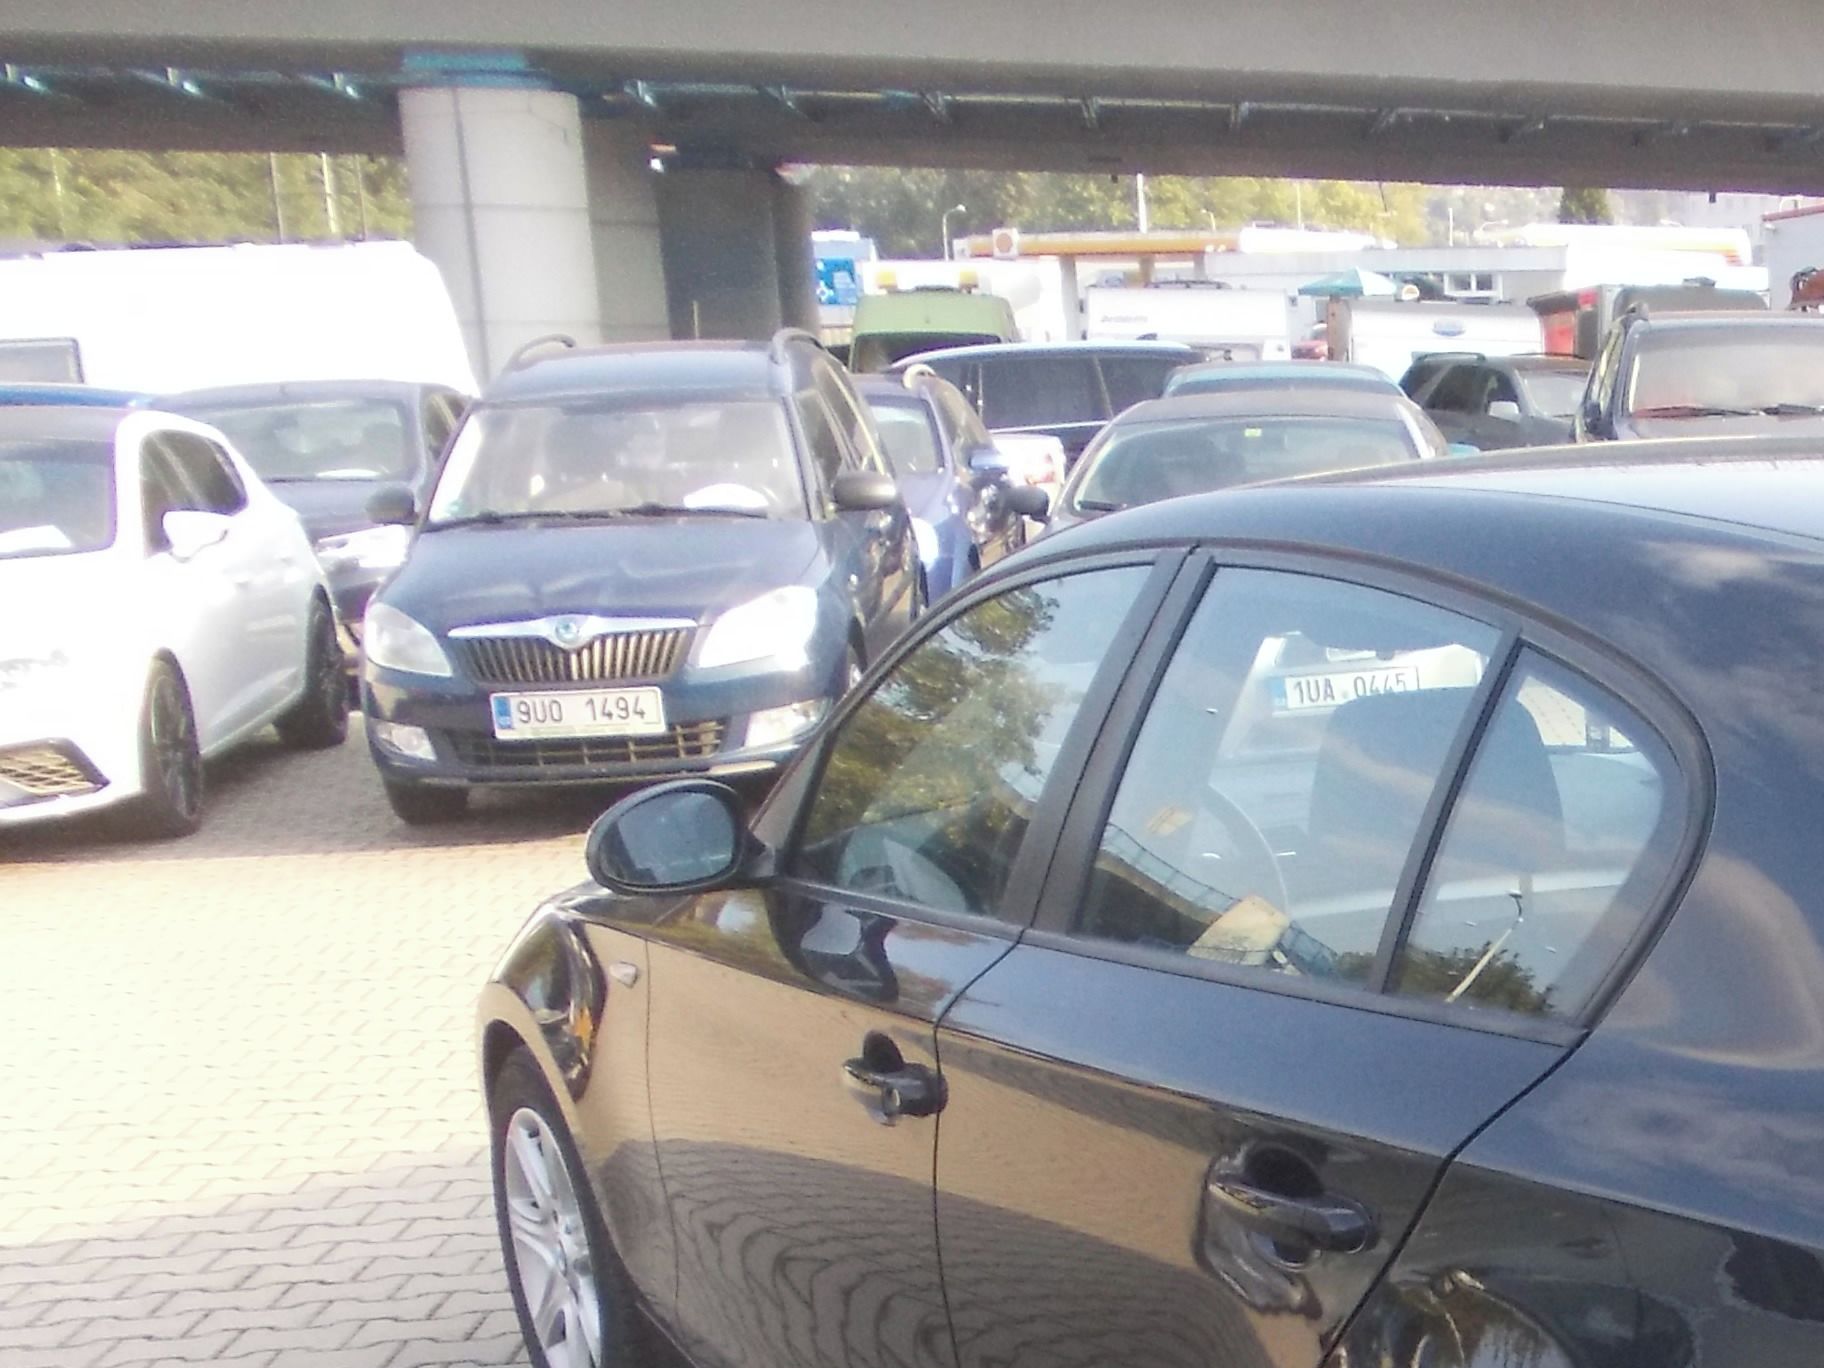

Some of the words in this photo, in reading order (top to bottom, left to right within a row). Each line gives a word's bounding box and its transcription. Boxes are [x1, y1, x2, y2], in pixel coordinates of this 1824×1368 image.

[1294, 677, 1336, 705] 1UA
[1353, 673, 1407, 699] 0445
[517, 700, 564, 724] 9U0
[585, 696, 646, 721] 1494
